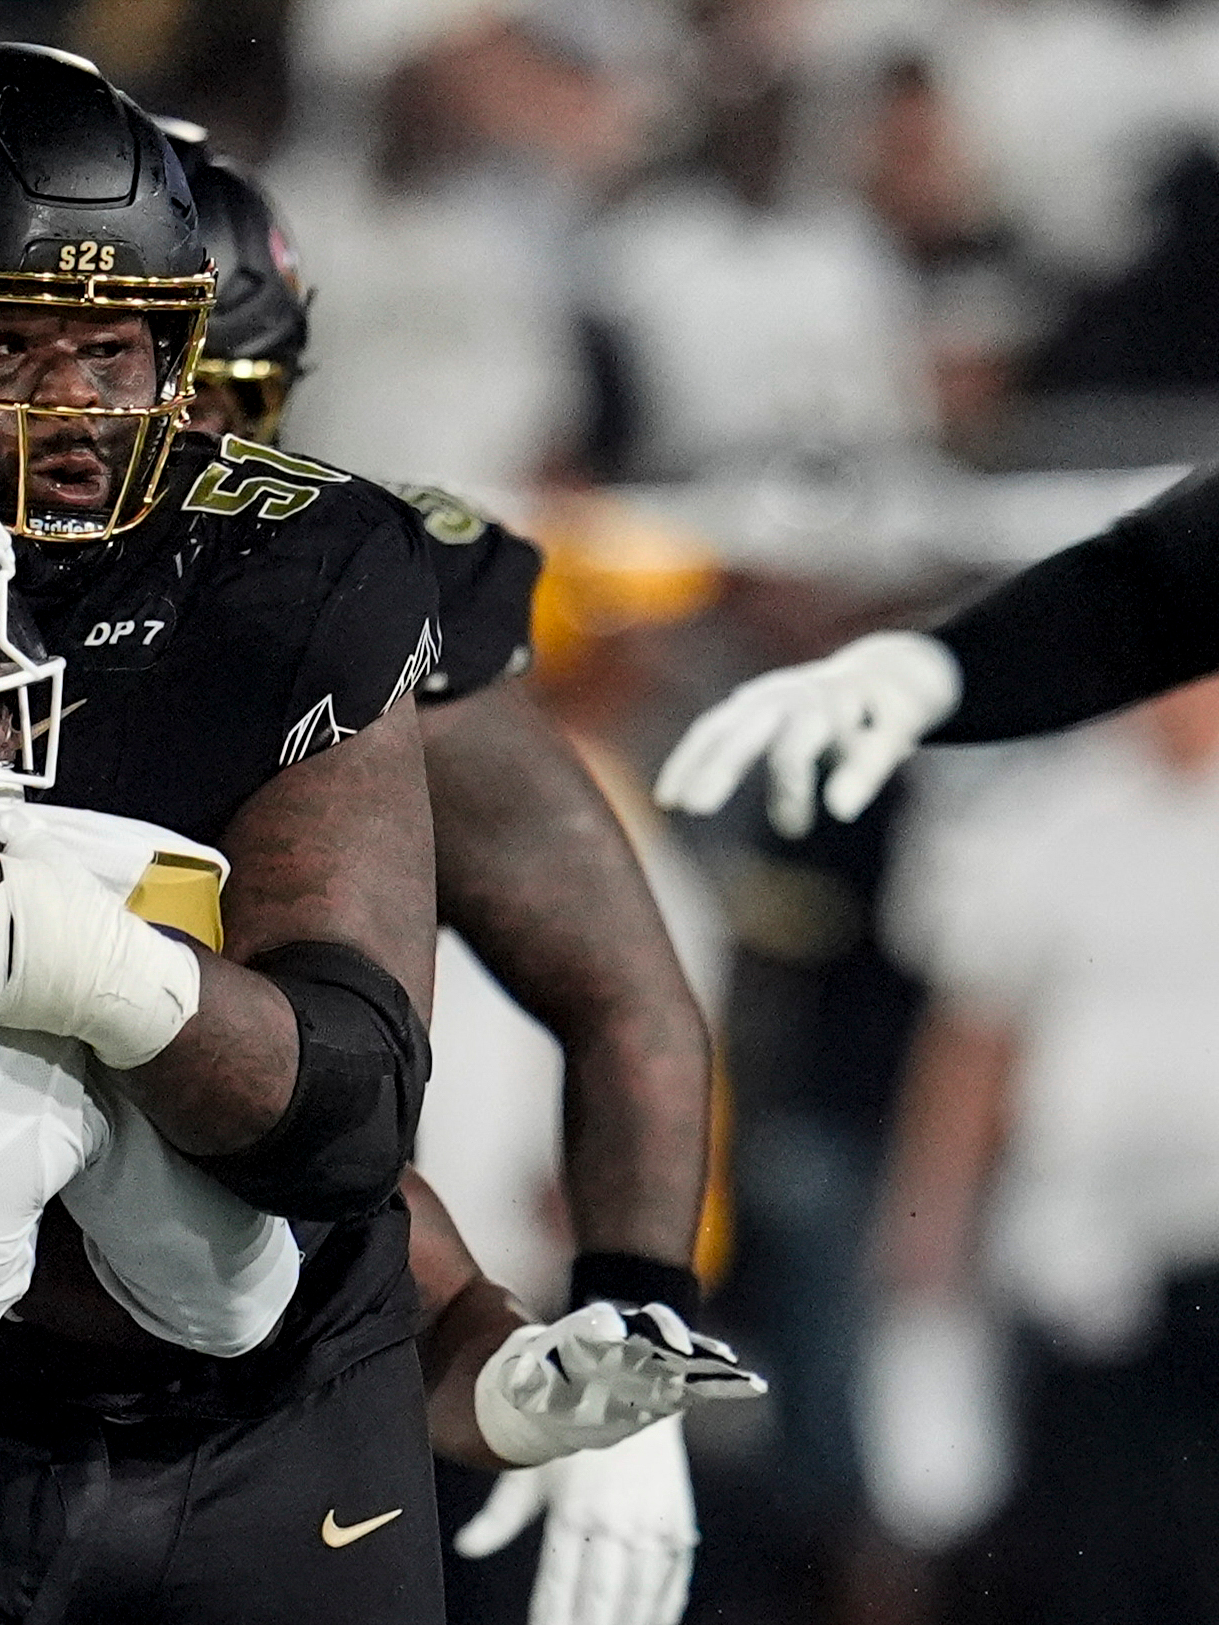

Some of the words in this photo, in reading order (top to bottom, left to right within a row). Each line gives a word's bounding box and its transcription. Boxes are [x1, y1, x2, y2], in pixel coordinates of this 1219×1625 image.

[181, 433, 353, 520] 51
[83, 620, 136, 647] DP
[142, 620, 165, 646] 7
